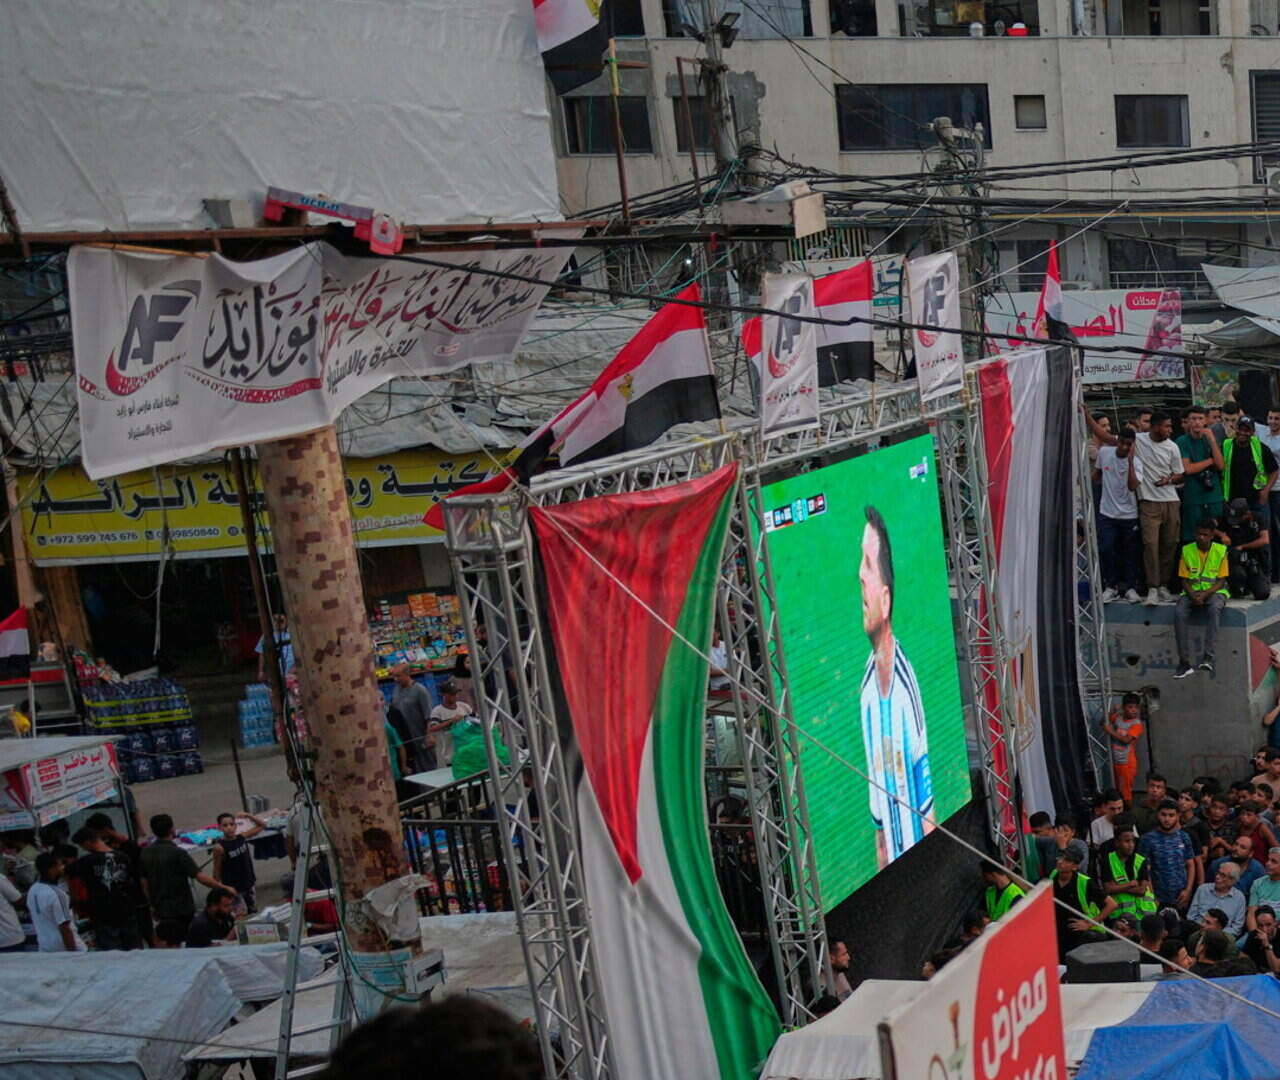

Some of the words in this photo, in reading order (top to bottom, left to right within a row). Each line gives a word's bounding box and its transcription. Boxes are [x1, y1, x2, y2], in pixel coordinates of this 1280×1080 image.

[1132, 296, 1156, 306] محلات
[117, 294, 193, 372] AF
[382, 462, 489, 503] كتبة
[76, 533, 97, 543] 599
[120, 531, 138, 541] 676
[157, 527, 219, 540] 099850840
[981, 965, 1047, 1080] معرض
